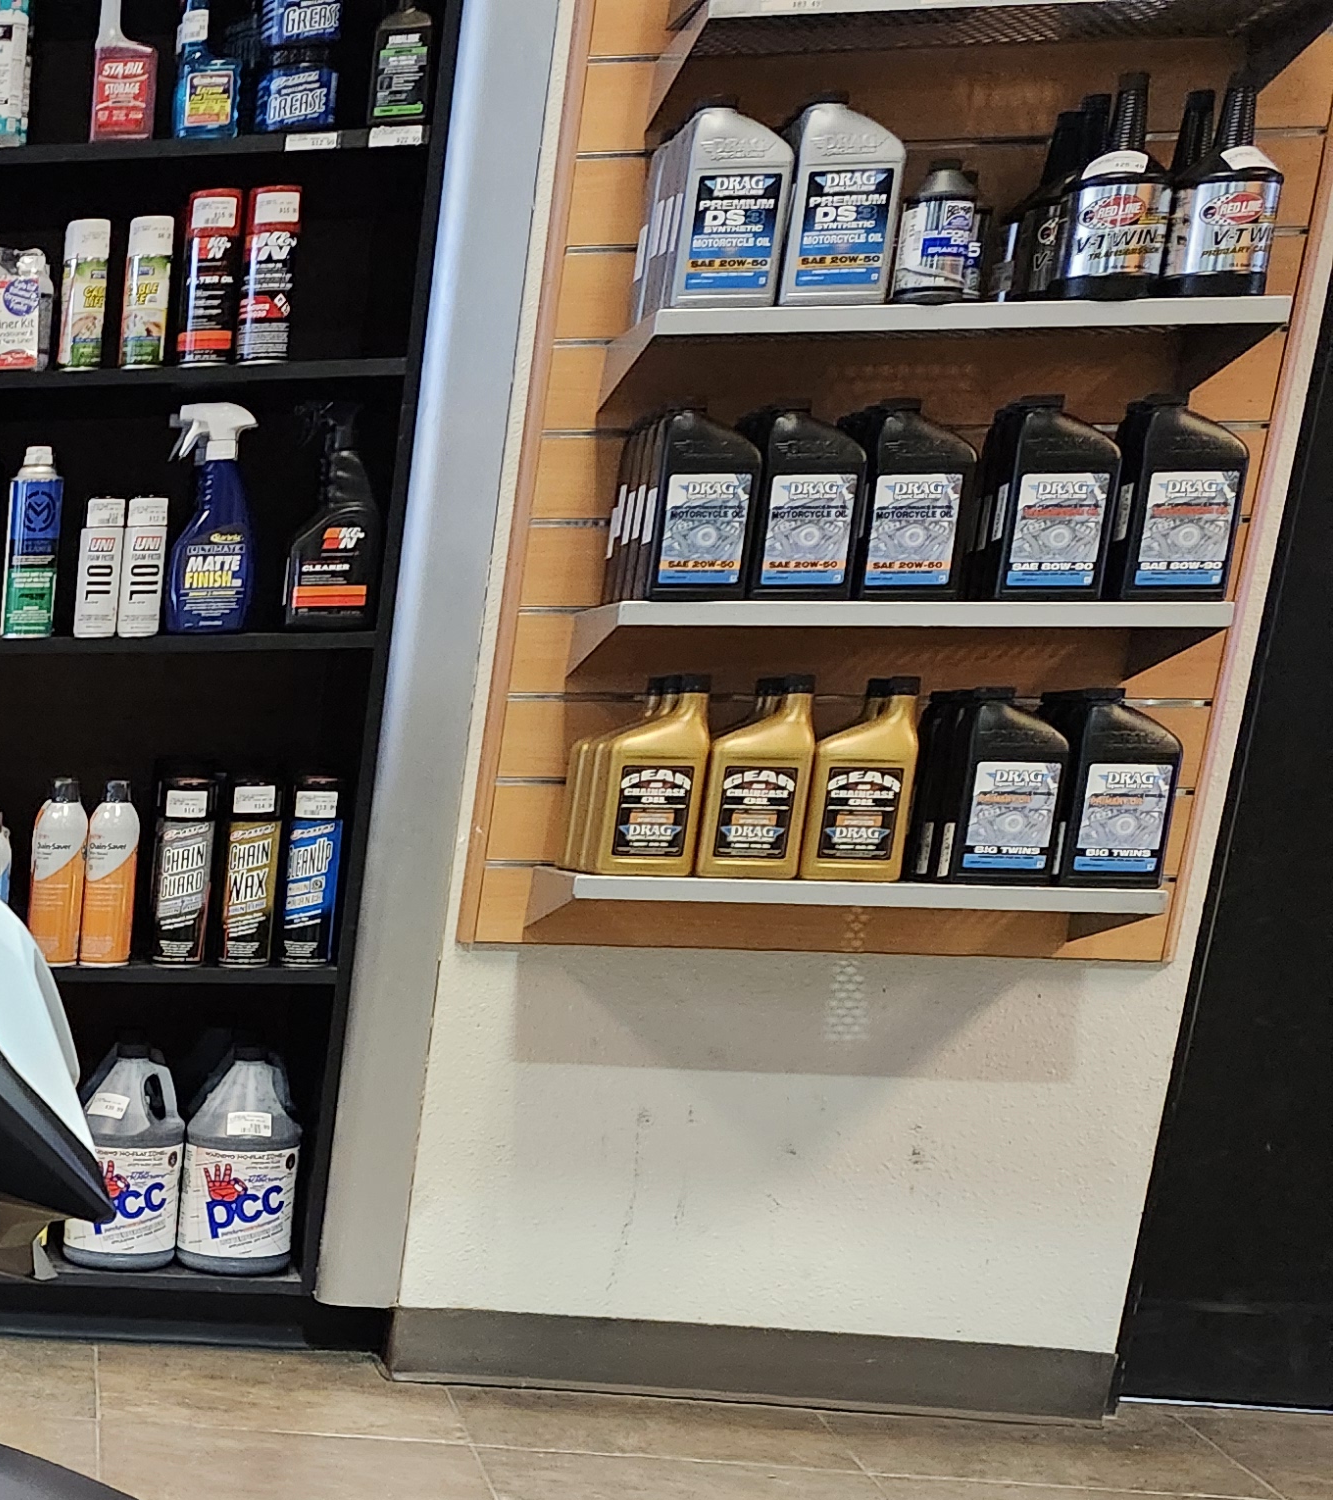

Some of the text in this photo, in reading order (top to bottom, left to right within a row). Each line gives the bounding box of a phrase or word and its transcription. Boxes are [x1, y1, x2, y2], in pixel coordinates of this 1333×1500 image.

[285, 4, 339, 34] GREASE
[105, 83, 140, 95] STORAGE
[267, 88, 326, 120] GREASE
[715, 176, 765, 190] DRAG
[826, 172, 877, 186] DRAG
[699, 199, 775, 211] PREMIUM
[809, 194, 887, 207] PREMIUM
[1097, 206, 1118, 219] RED
[1219, 200, 1263, 215] RED LINE
[704, 225, 763, 233] SYNTHETIC
[814, 221, 875, 230] SYNTHETIC
[692, 237, 771, 247] MOTORCYCLE OIL
[803, 233, 883, 245] MOTORCYCLE OIL
[1076, 229, 1158, 254] V-TWIN
[690, 258, 768, 267] SAE 20W-50
[801, 255, 880, 265] SAE 20W-50
[21, 318, 34, 330] Kit
[688, 482, 735, 495] DRAG
[789, 481, 838, 495] DRAG
[894, 481, 944, 495] DRAG
[670, 509, 728, 519] MOTORCYCLE
[772, 509, 832, 519] MOTORCYCLE
[876, 509, 938, 519] MOTORCYCLE
[90, 538, 115, 551] UNI
[135, 537, 160, 550] UNI
[187, 555, 241, 572] MATTE
[1012, 562, 1038, 570] SAE
[1140, 562, 1167, 570] SAE
[85, 564, 113, 601] OIL
[129, 563, 160, 601] OIL
[185, 571, 232, 589] FINISH
[620, 769, 691, 790] GEAR
[723, 769, 795, 792] GEAR
[827, 771, 901, 793] GEAR
[994, 769, 1044, 783] DRAG
[1107, 771, 1155, 785] DRAG
[743, 797, 770, 805] OIL
[848, 798, 875, 806] OIL
[629, 825, 673, 837] DRAG
[731, 826, 775, 838] DRAG
[835, 827, 880, 840] DRAG
[229, 839, 272, 871] CHAIN
[974, 846, 1040, 855] BIG TWINS
[1086, 849, 1151, 858] BIG TWINS
[163, 841, 207, 874] CHAIN
[161, 869, 204, 899] GUARD
[229, 868, 269, 906] WAX
[205, 1185, 284, 1239] pcc
